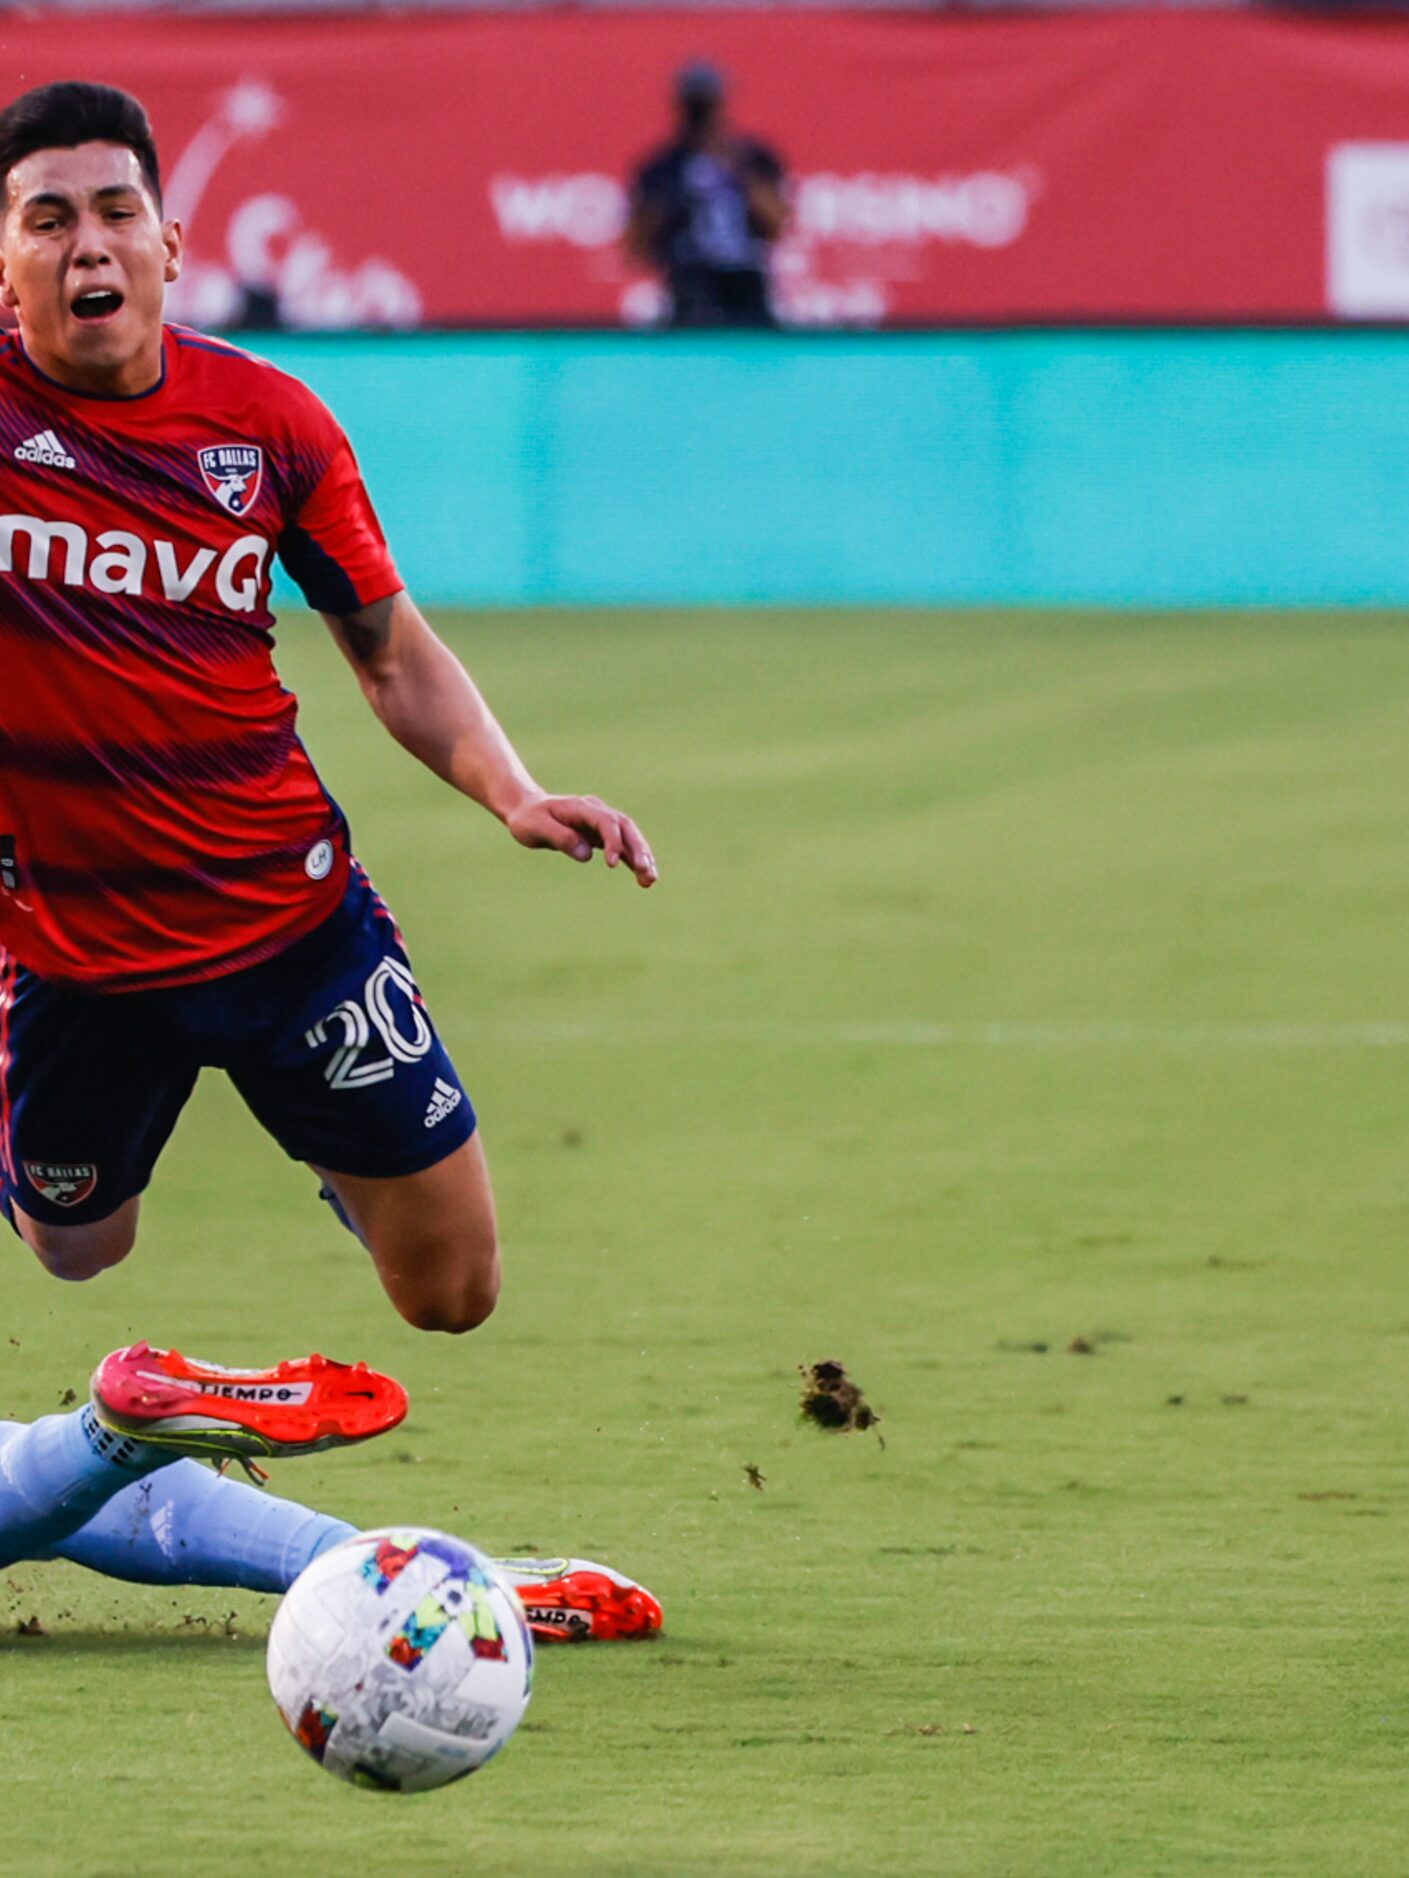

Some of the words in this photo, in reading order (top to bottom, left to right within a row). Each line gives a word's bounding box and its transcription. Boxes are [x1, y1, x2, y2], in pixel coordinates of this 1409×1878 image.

[14, 446, 76, 469] adidas
[202, 451, 217, 469] FC
[218, 449, 257, 467] DALLAS
[304, 955, 432, 1089] 20
[424, 1089, 461, 1128] adida
[198, 1381, 292, 1401] TIEMPO
